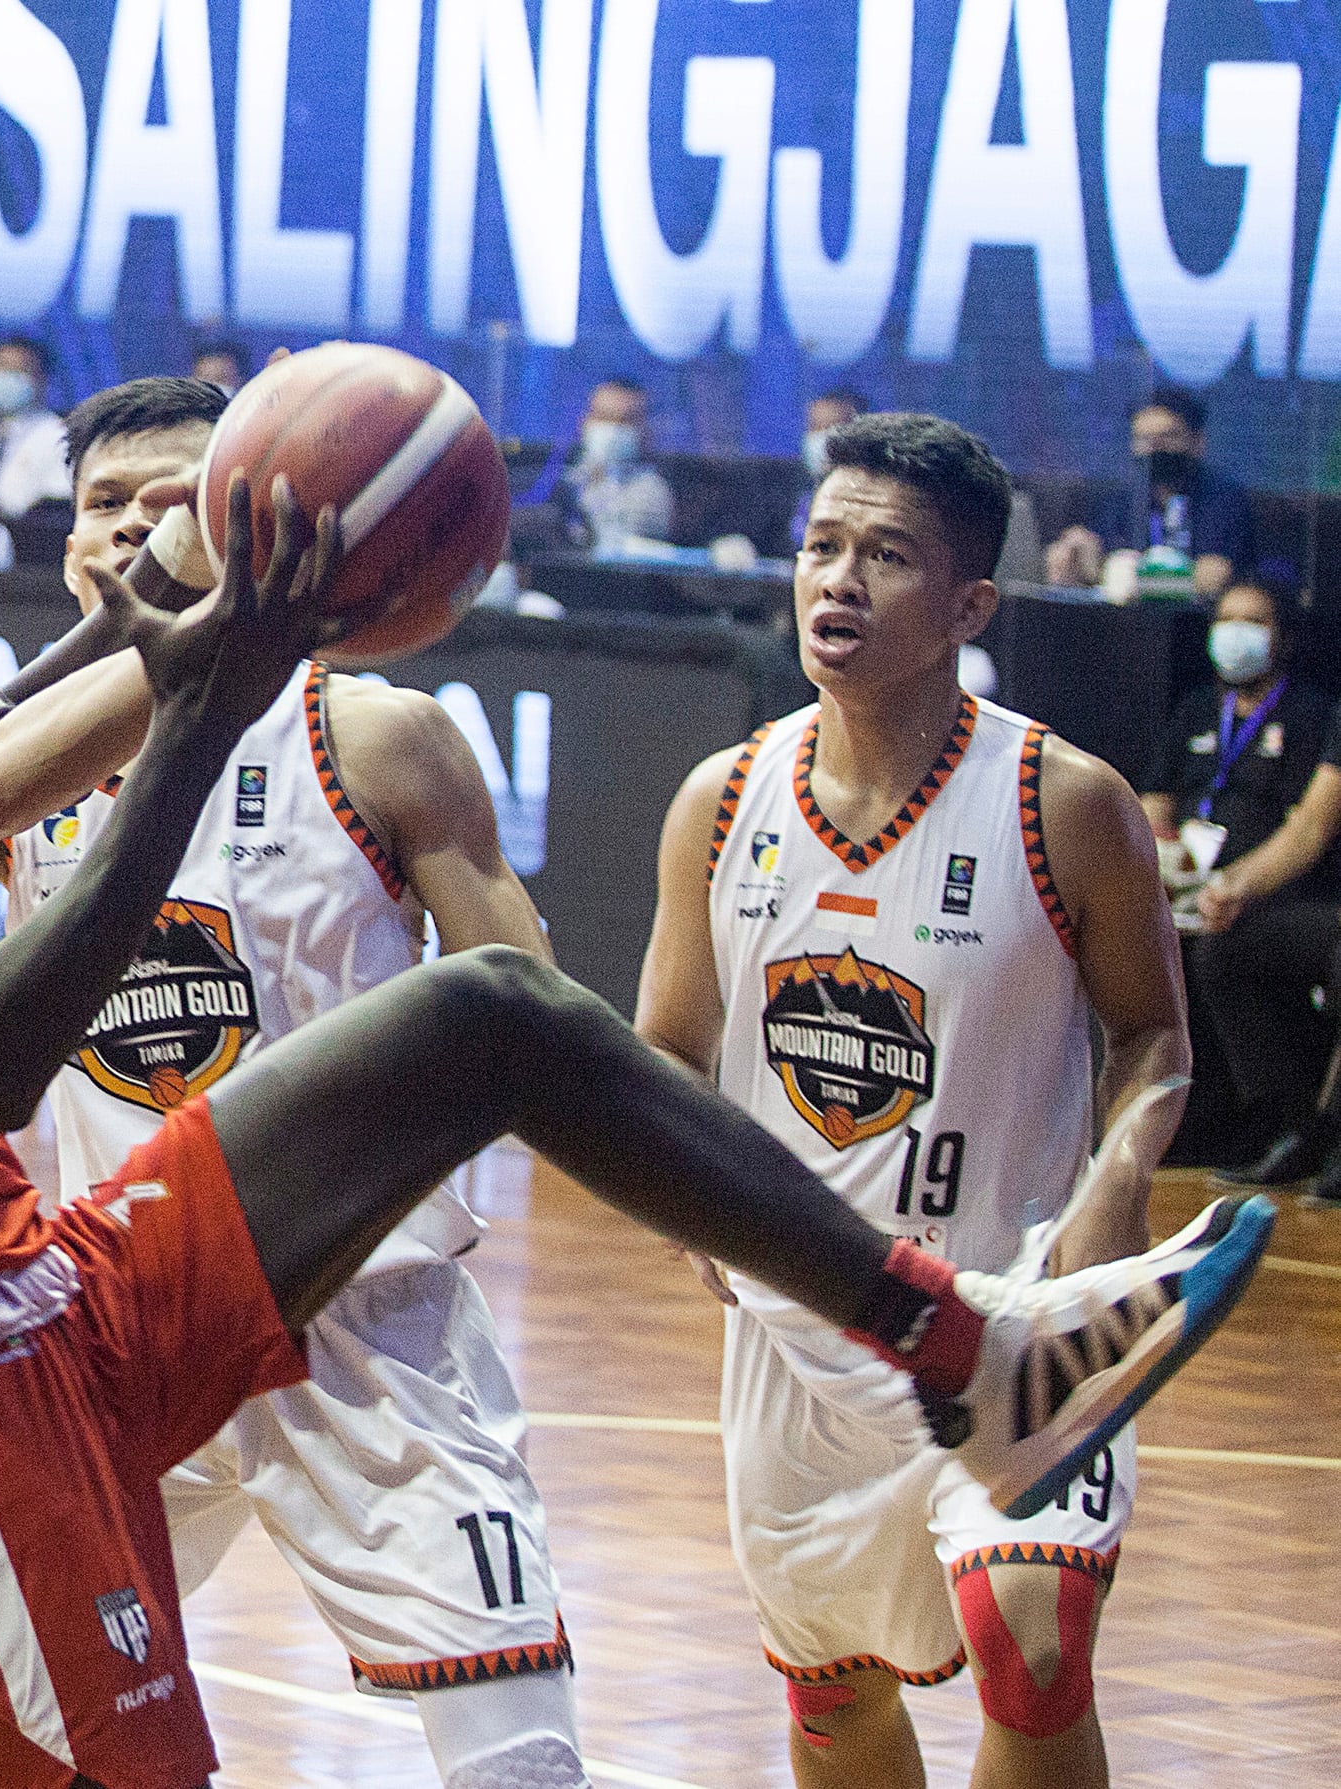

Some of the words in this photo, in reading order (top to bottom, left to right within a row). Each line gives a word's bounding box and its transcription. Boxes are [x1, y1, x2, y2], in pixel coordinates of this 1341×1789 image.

[85, 983, 184, 1037] UNTAIN
[185, 980, 251, 1017] GOLD
[767, 1022, 866, 1070] MOUNTAIN
[869, 1041, 928, 1086] GOLD
[895, 1124, 965, 1218] 19
[454, 1509, 525, 1610] 17
